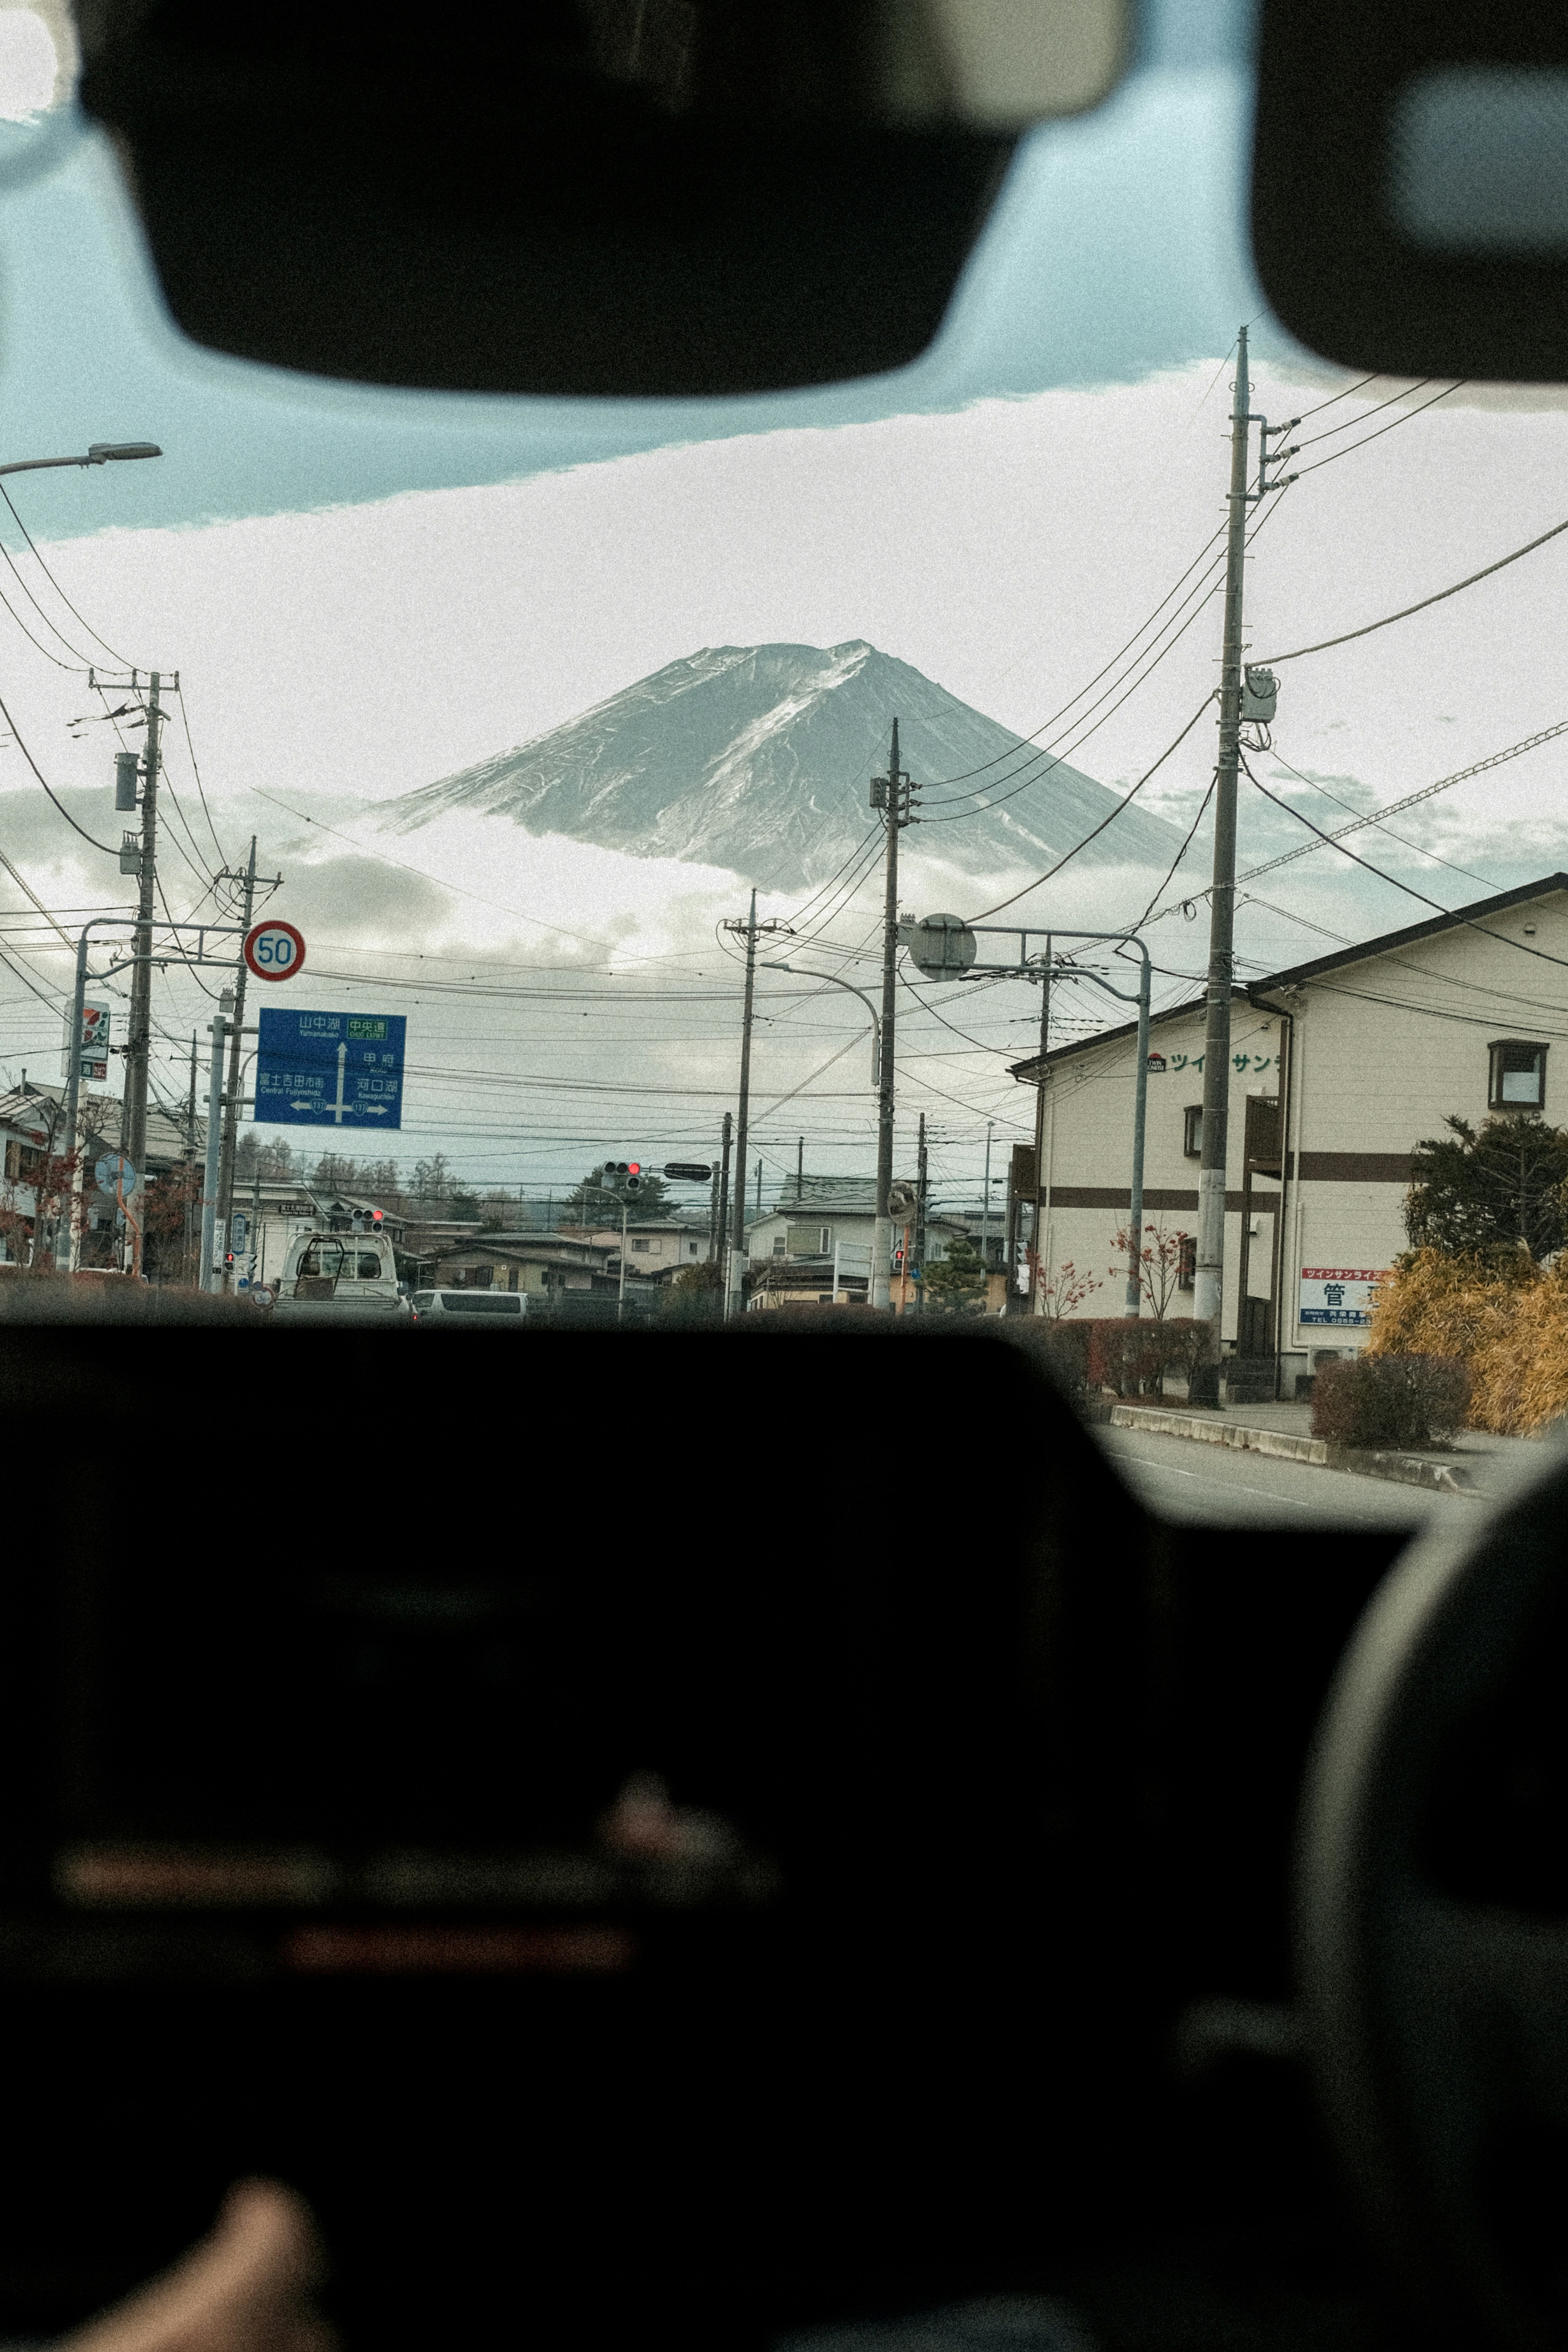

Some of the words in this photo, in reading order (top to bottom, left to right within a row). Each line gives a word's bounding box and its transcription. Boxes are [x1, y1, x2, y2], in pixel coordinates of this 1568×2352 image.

[258, 937, 291, 965] 50
[299, 1016, 340, 1031] 山中湖
[349, 1021, 385, 1032] 中央道
[299, 1030, 339, 1038] Yamanakako
[83, 1064, 91, 1075] 酒
[94, 1066, 105, 1078] たばこ
[259, 1073, 325, 1089] 富士吉田市街
[356, 1078, 398, 1093] 河口湖
[286, 1088, 321, 1097] Fujiyoshida
[358, 1092, 396, 1101] Kawaguchiko
[312, 1101, 325, 1109] 137
[354, 1104, 367, 1112] 137
[1307, 1270, 1381, 1281] ツインサンライズ
